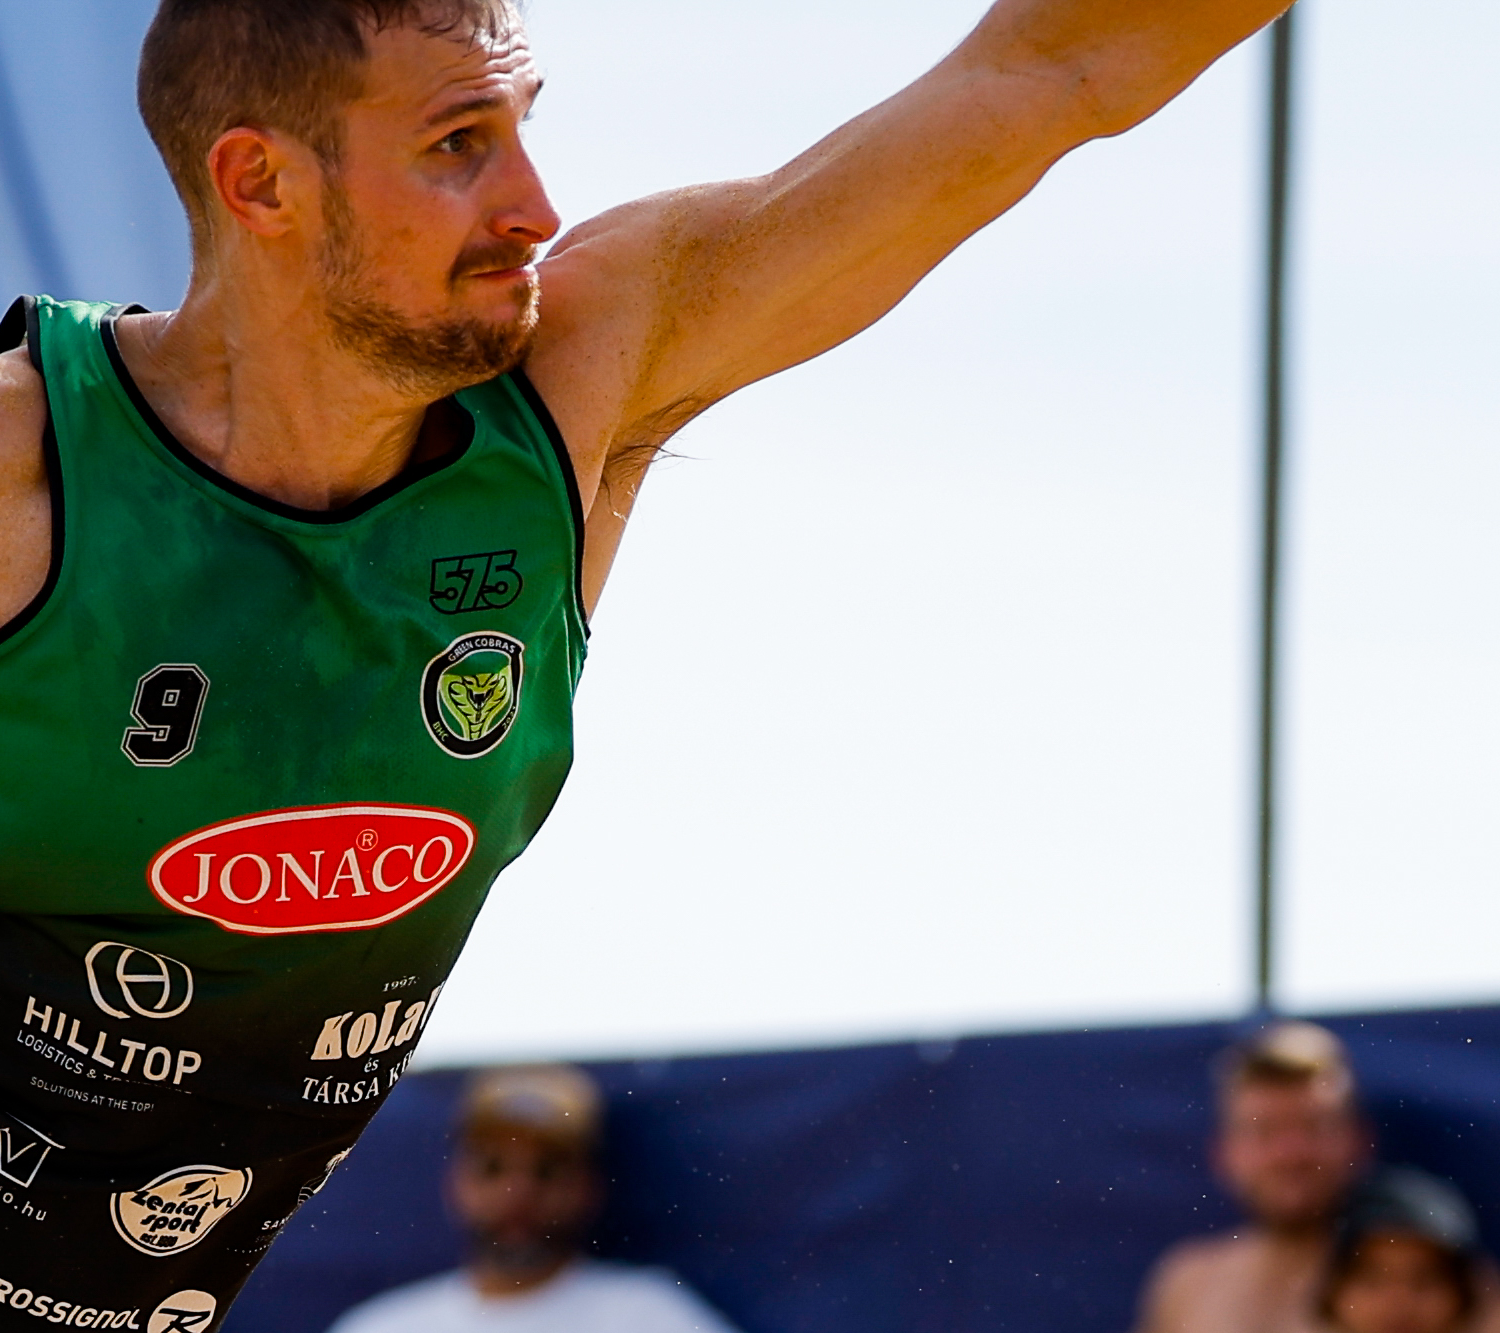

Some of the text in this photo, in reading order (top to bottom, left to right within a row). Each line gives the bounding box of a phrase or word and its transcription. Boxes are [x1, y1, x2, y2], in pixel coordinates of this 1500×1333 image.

[430, 550, 523, 615] 575
[448, 637, 516, 662] GREEN COBRAS
[121, 664, 210, 767] 9
[432, 720, 449, 742] BHC
[183, 836, 454, 904] JONACO
[16, 1029, 98, 1079] LOGISTICS &
[23, 996, 202, 1085] HILLTOP
[364, 1058, 380, 1073] és
[30, 1076, 89, 1102] SOLUTIONS
[91, 1095, 105, 1106] AT
[108, 1097, 128, 1110] THE
[131, 1101, 155, 1112] TOP!
[302, 1076, 380, 1104] TÁRSA
